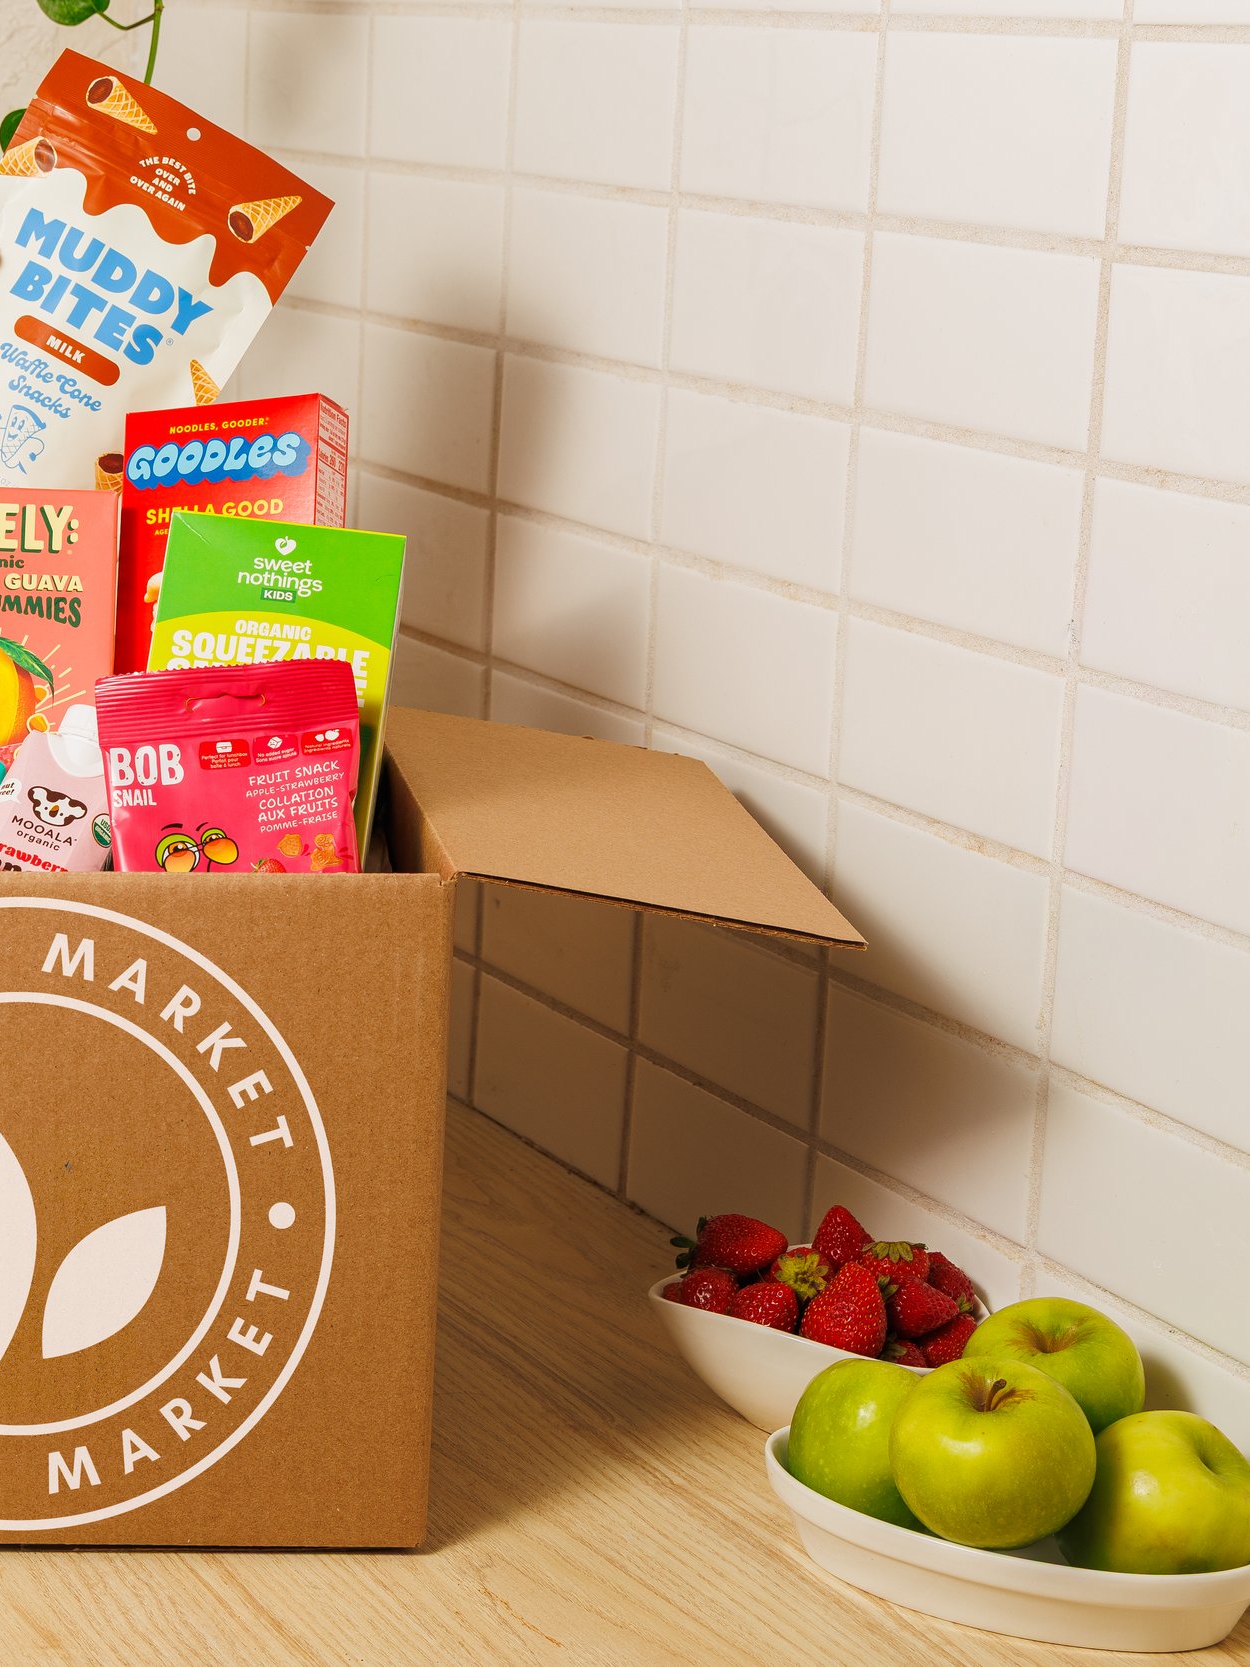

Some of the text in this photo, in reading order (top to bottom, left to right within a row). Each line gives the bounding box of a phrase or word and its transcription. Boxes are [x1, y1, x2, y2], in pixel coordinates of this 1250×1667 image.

[139, 156, 196, 195] THE BEST BITE
[152, 177, 173, 192] AND
[155, 168, 181, 186] OVER
[130, 176, 186, 211] OVER AGAIN
[15, 207, 214, 336] MUDDY
[9, 260, 164, 366] BITES
[45, 334, 87, 365] MILK
[0, 342, 102, 412] Waffle Cone
[8, 375, 71, 419] Snacks
[169, 421, 218, 434] NOODLES,
[127, 431, 304, 484] GOODLES
[222, 499, 284, 517] GOOD
[253, 556, 312, 575] sweet
[4, 573, 84, 592] GUAVA
[237, 570, 323, 598] nothings
[263, 589, 293, 601] KIDS
[235, 619, 312, 640] ORGANIC
[109, 743, 185, 787] BOB
[265, 749, 281, 757] added
[281, 747, 295, 756] sugar
[245, 771, 344, 798] APPLE-STRAWBERRY
[249, 760, 340, 787] FRUIT SNACK
[112, 788, 157, 808] SNAIL
[257, 797, 339, 823] AUX FRUITS
[259, 785, 334, 810] COLLATION
[11, 815, 73, 846] MOOALA
[260, 811, 338, 833] POMME-FRAISE
[16, 829, 60, 851] organic
[41, 932, 295, 1151] MARKET
[49, 1268, 293, 1495] MARKET
